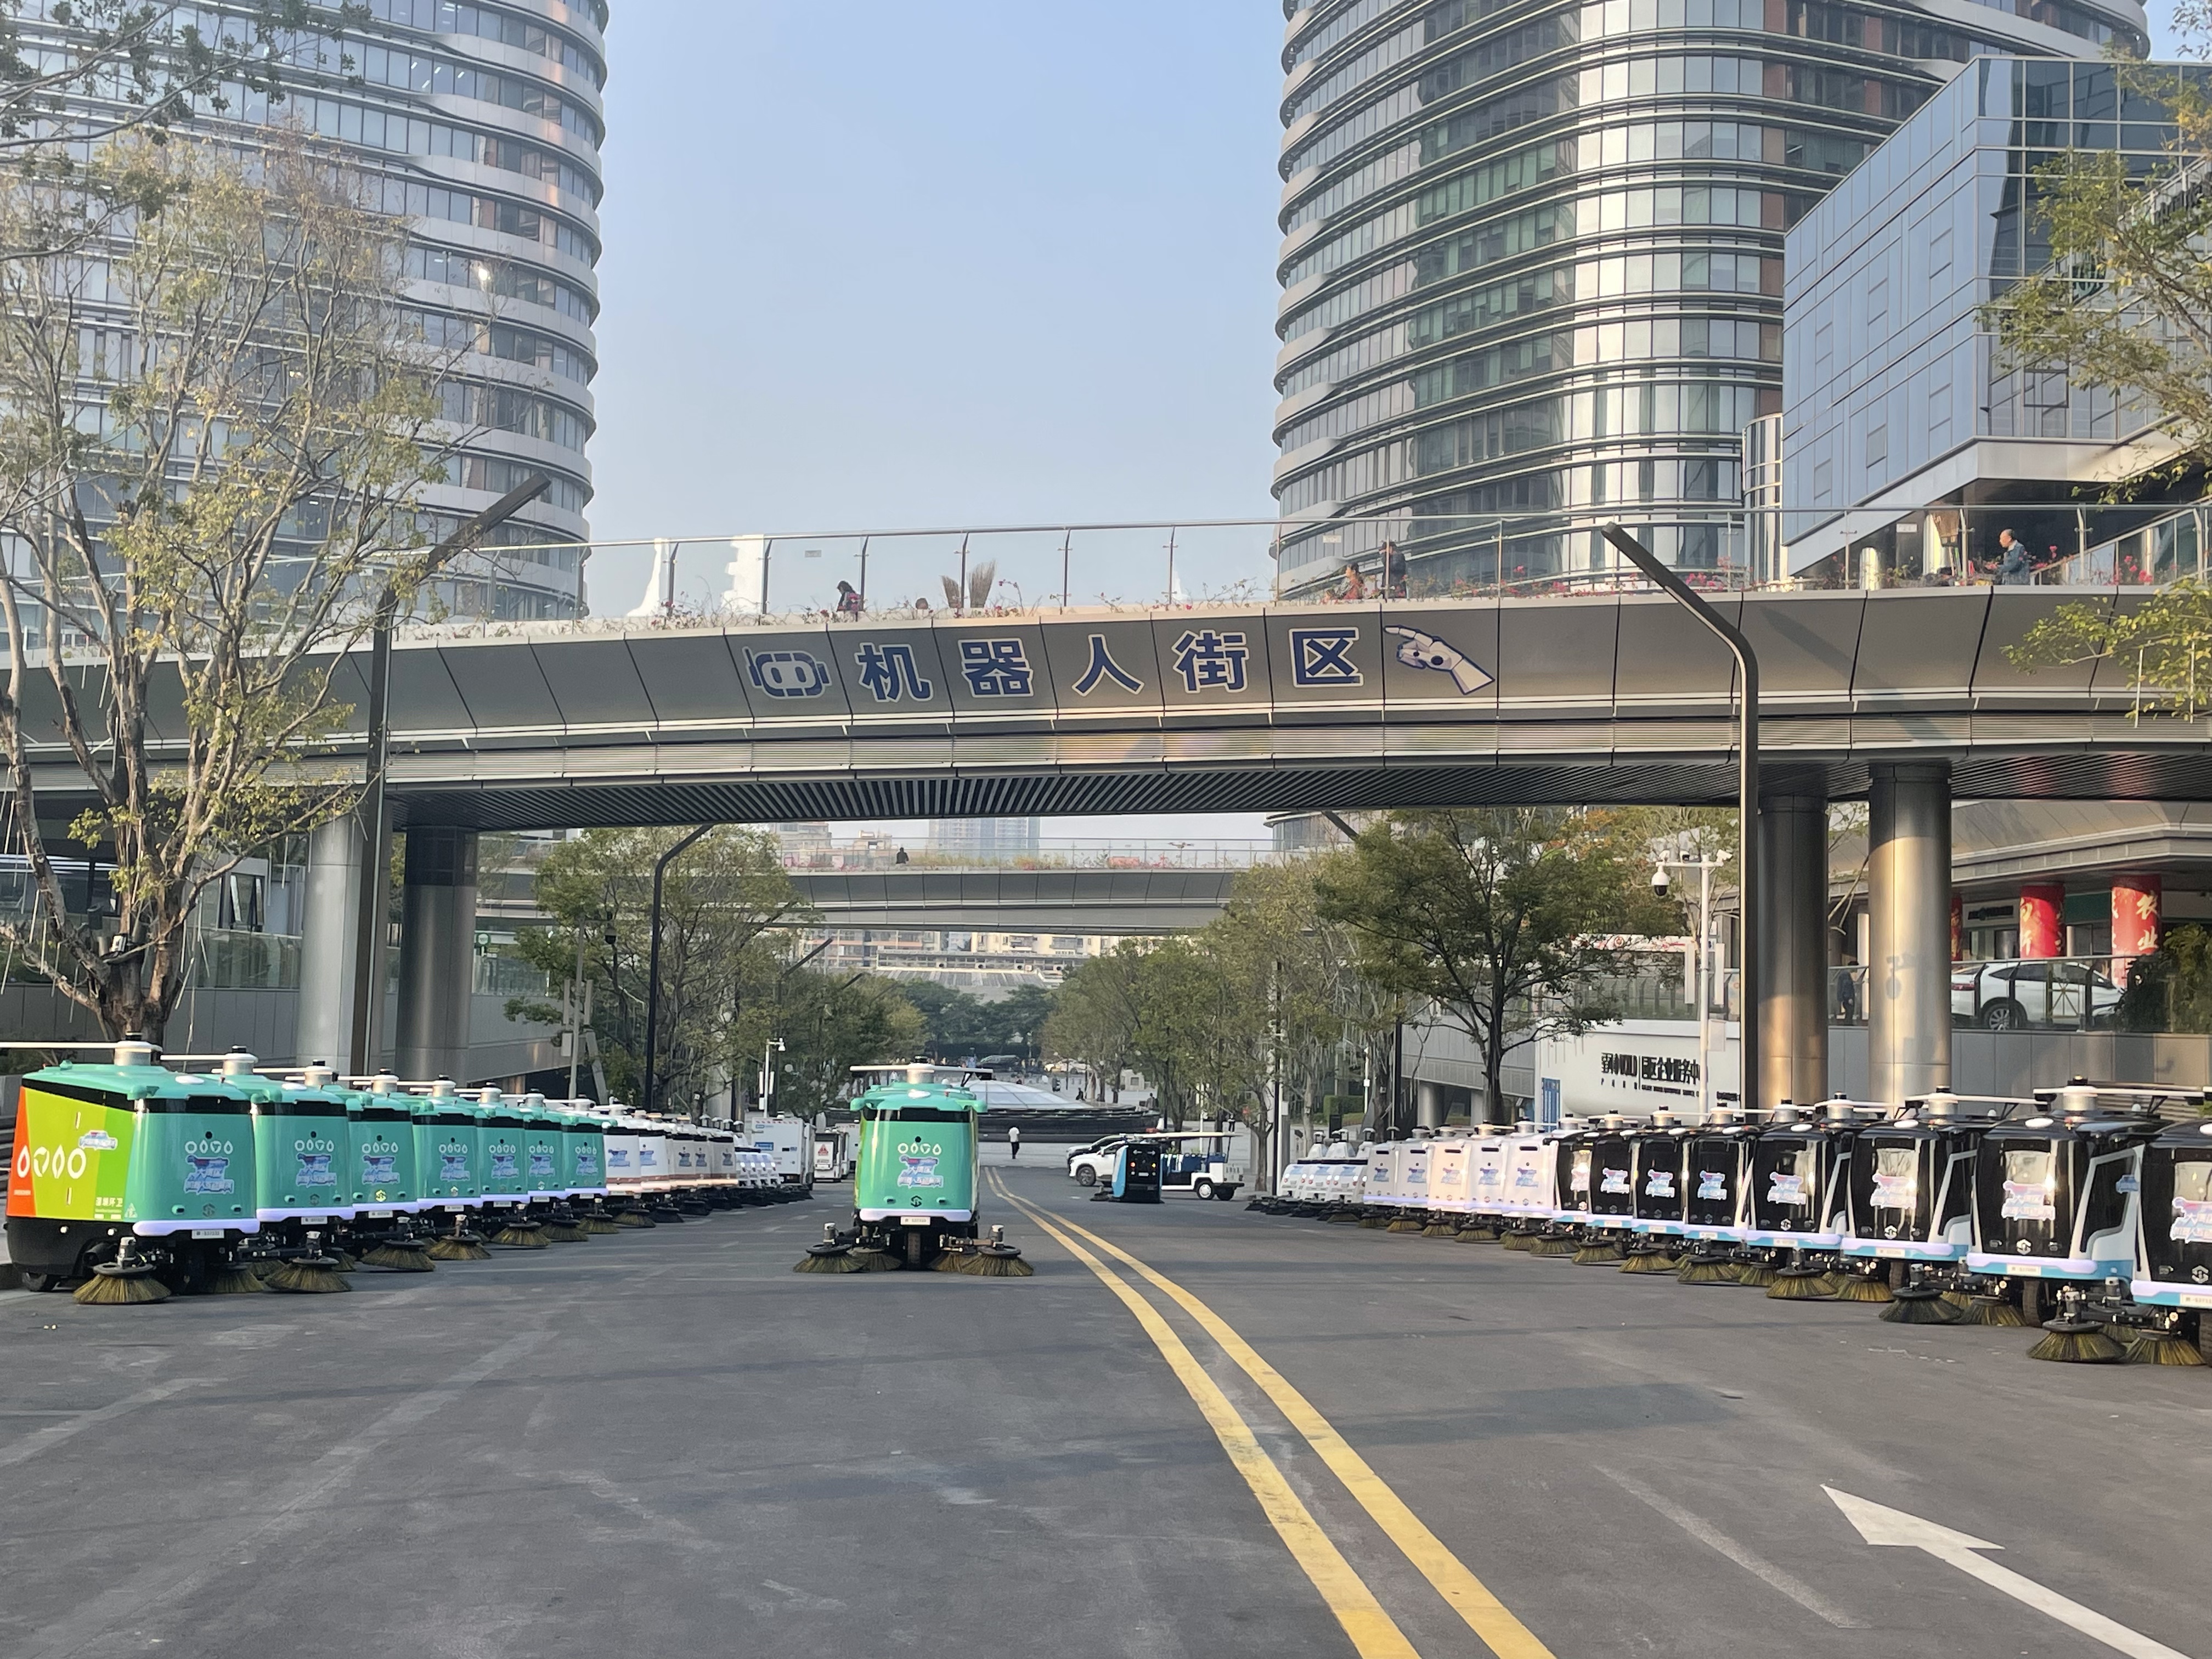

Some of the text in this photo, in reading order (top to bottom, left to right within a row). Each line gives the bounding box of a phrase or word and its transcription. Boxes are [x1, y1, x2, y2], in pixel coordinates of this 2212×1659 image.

[855, 627, 1364, 702] 机器人街区
[2136, 890, 2159, 951] 农业
